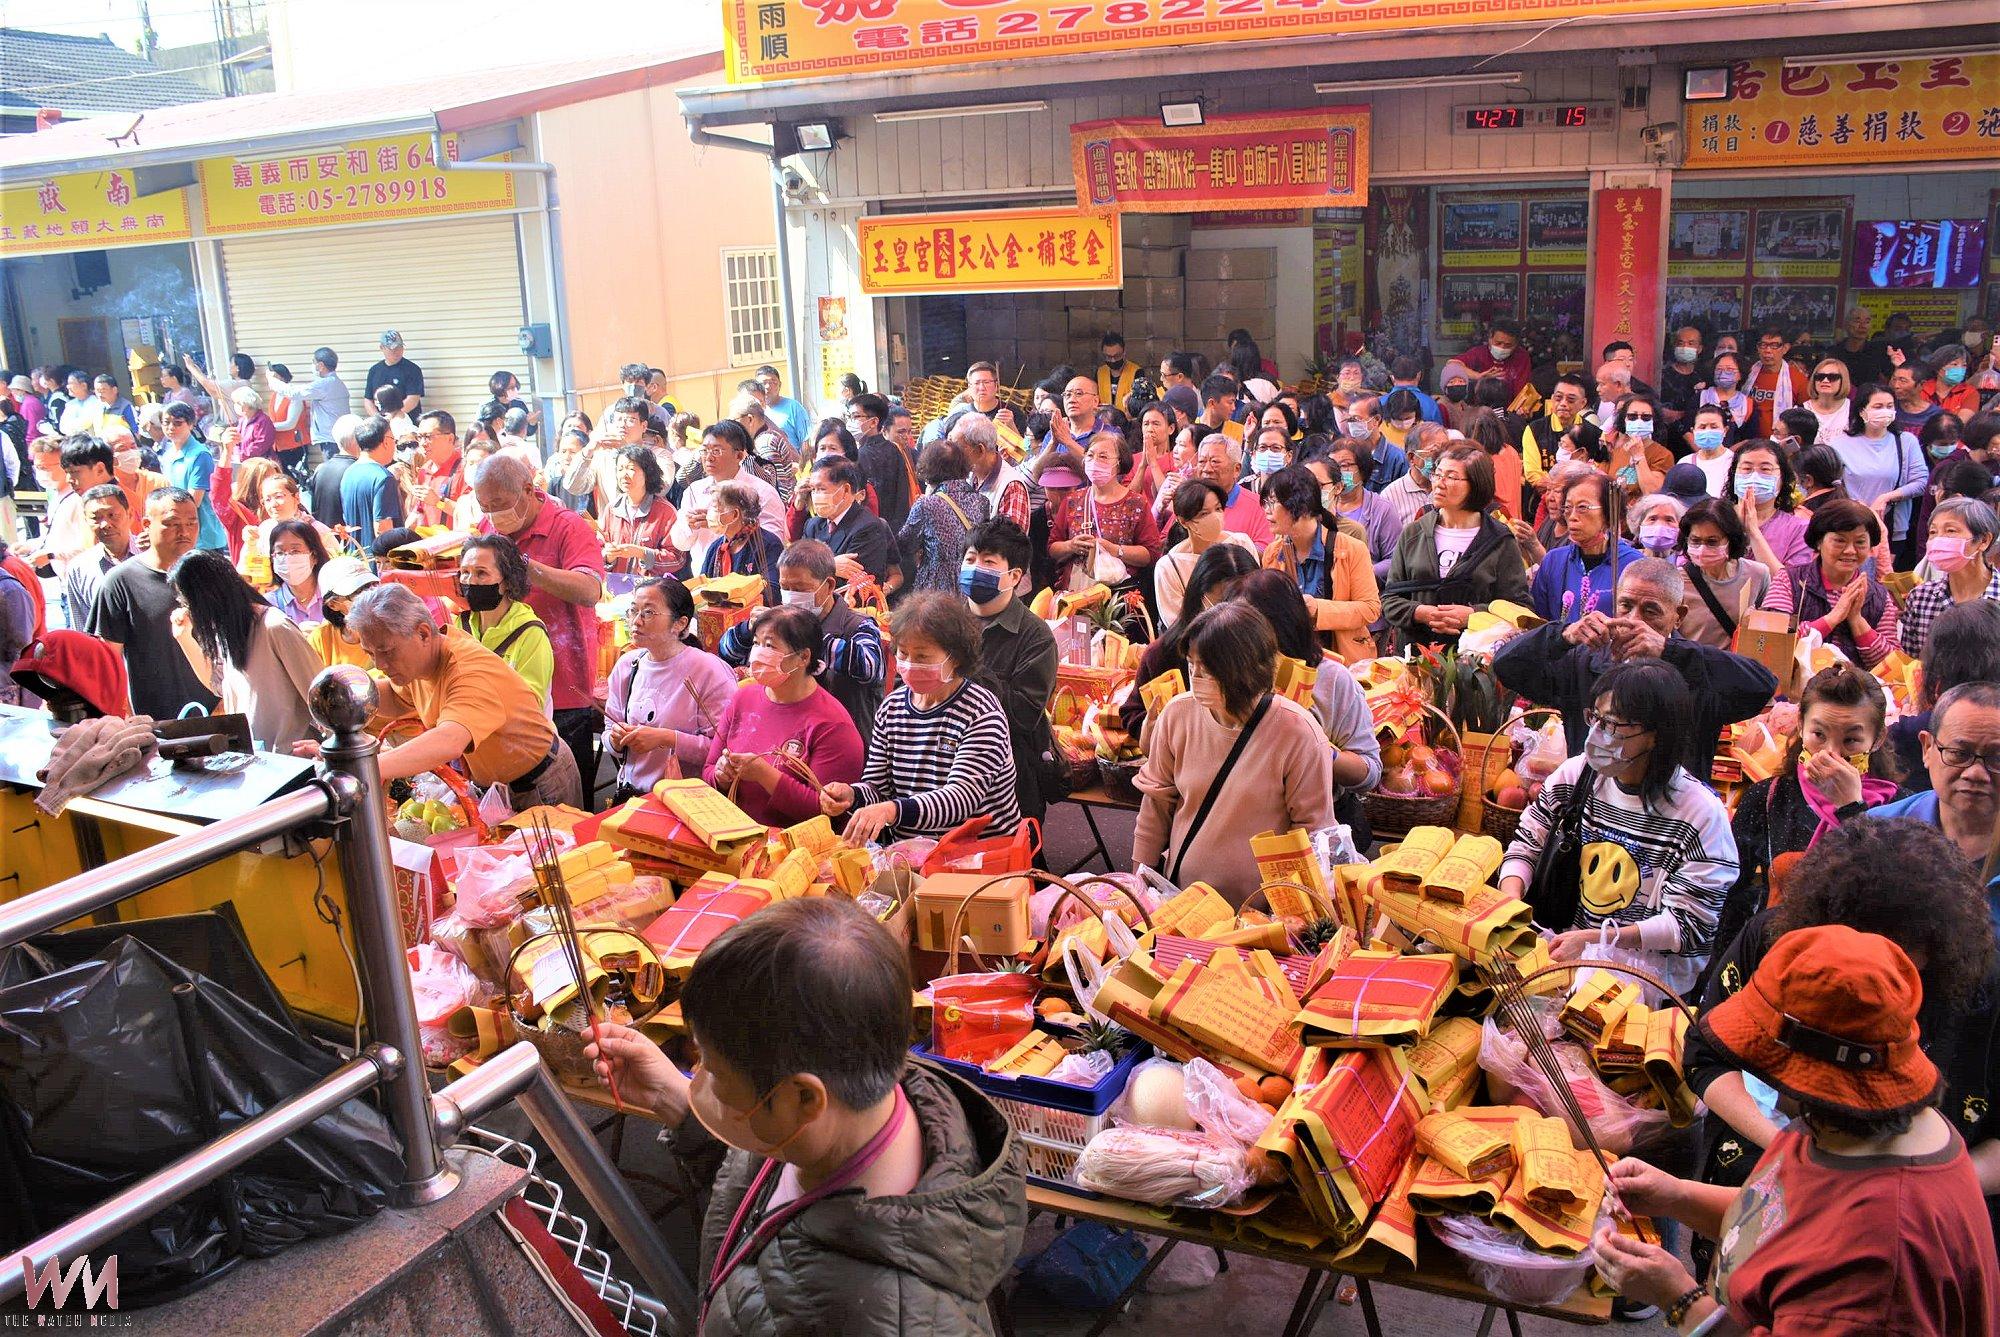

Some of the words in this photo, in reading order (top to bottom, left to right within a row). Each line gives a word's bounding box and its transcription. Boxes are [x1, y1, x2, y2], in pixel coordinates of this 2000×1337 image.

[998, 0, 1387, 36] 27822
[758, 2, 788, 61] 雨順
[1475, 107, 1517, 129] 427
[1564, 105, 1586, 127] 15
[1702, 113, 1744, 134] 捐款
[1797, 110, 1926, 146] 慈善捐款
[1702, 135, 1739, 154] 項目
